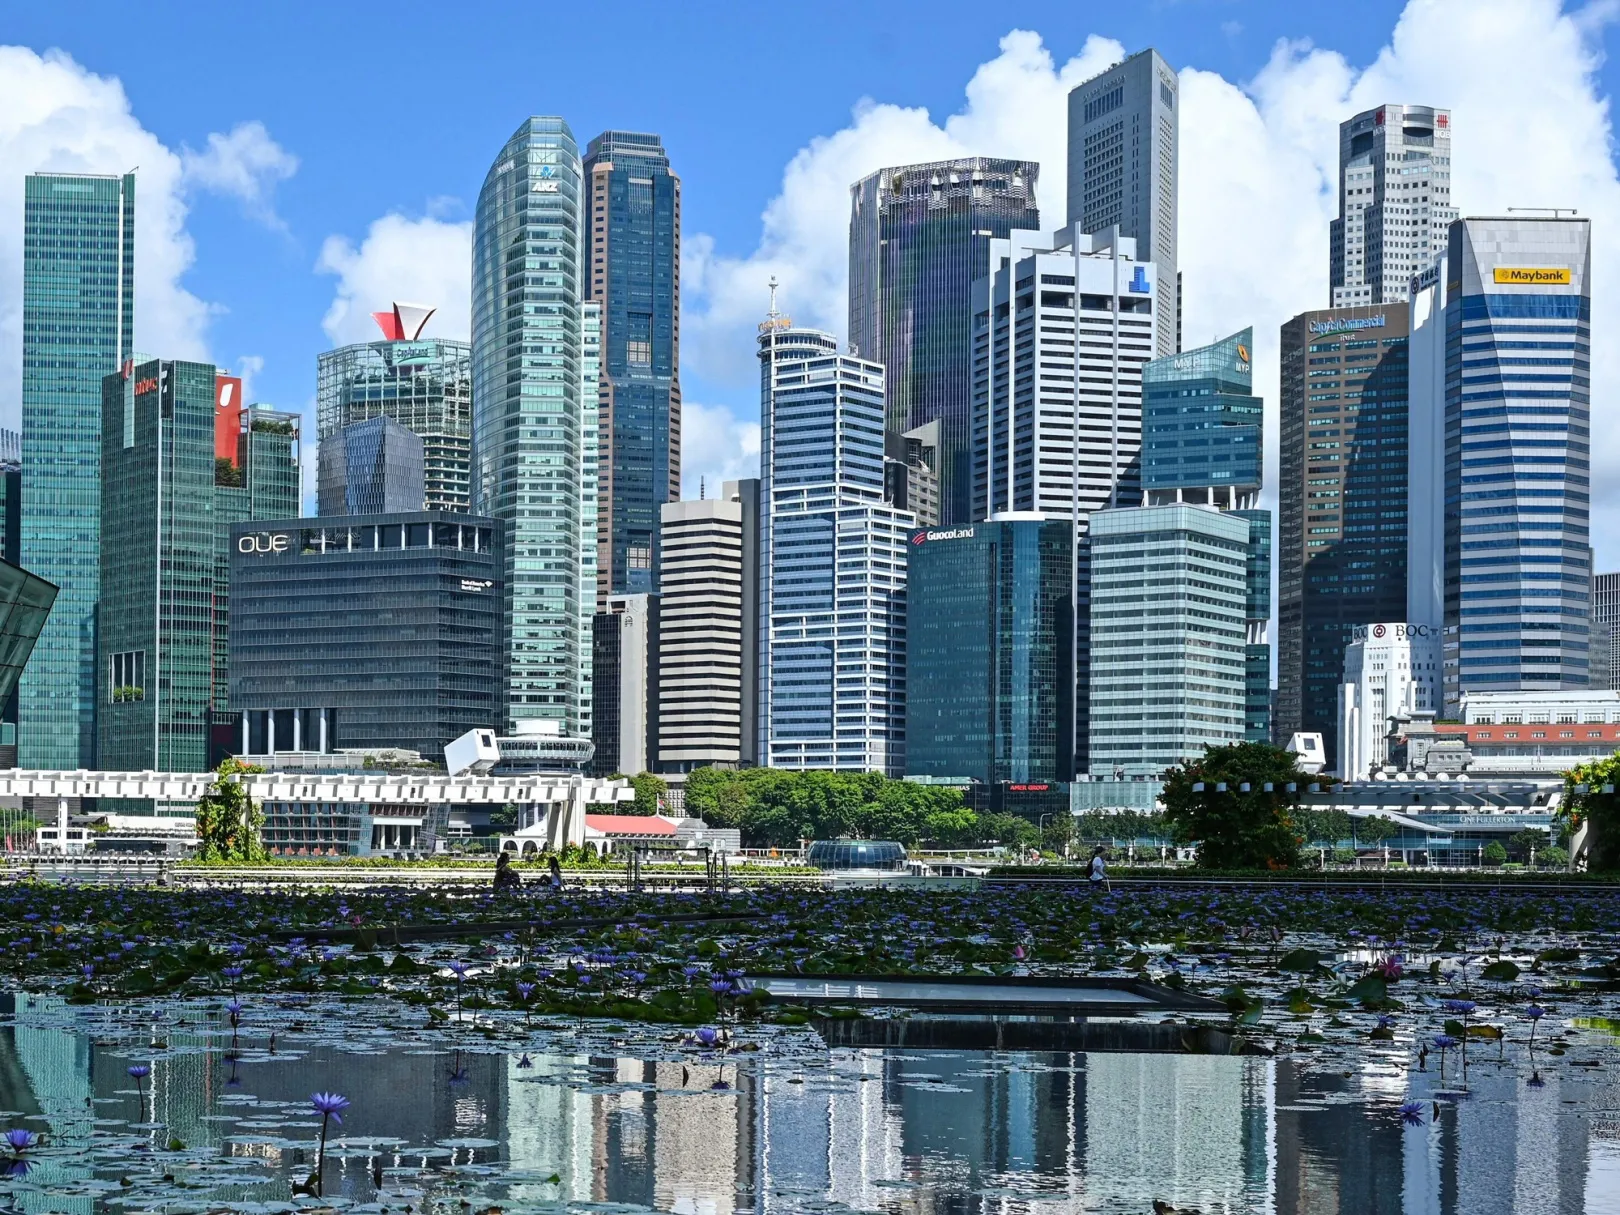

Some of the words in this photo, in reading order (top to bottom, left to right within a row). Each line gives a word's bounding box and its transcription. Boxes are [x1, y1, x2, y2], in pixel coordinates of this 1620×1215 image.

[1434, 130, 1451, 139] UOB
[532, 181, 558, 192] ANZ
[1510, 270, 1563, 281] Maybank
[1236, 362, 1250, 375] MYP
[926, 527, 974, 541] GuocoLand
[239, 534, 288, 553] OUE
[1353, 626, 1368, 640] BOC
[1395, 624, 1429, 637] BOC
